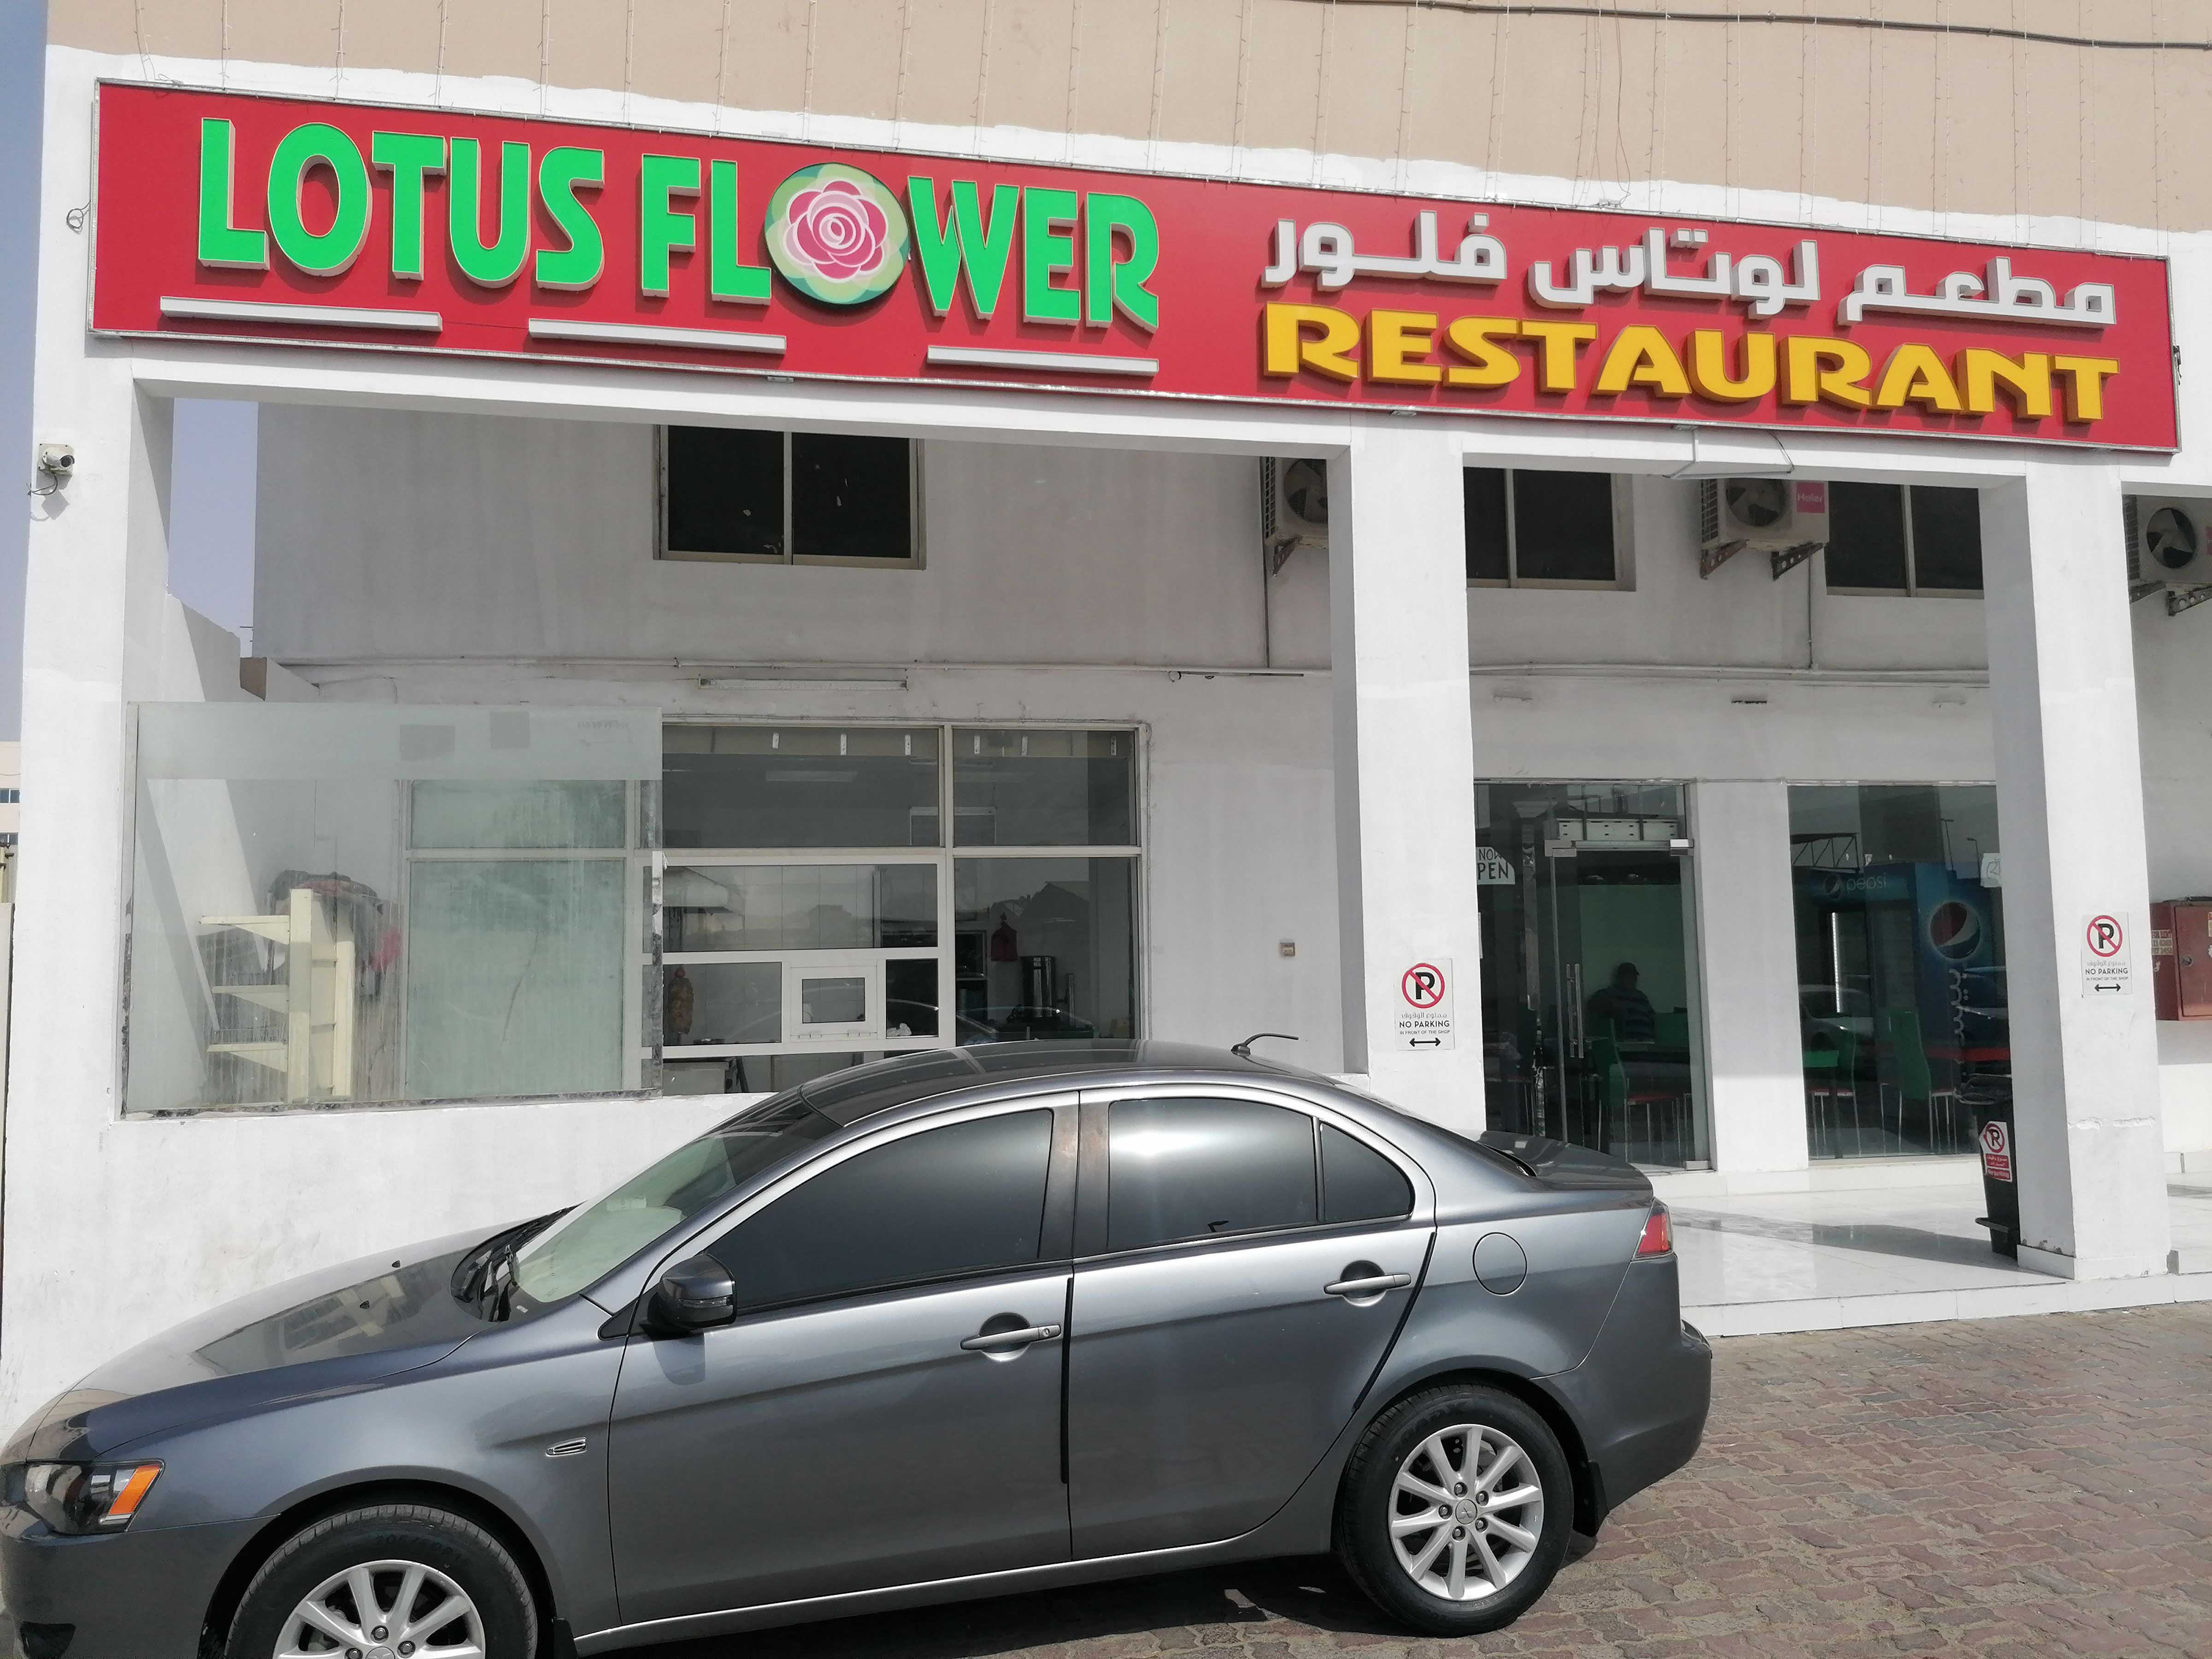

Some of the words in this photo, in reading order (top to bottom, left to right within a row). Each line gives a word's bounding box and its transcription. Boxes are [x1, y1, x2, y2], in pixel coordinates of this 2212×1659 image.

[199, 118, 605, 291] LOTUS
[1261, 210, 1507, 293] فلور
[1529, 227, 1820, 320] لوتاس
[1837, 256, 2117, 329] مطعم
[1263, 301, 2120, 423] RESTAURANT
[1477, 861, 1509, 880] PEN
[1847, 872, 1887, 892] pepsi
[1414, 1020, 1450, 1028] PARKING
